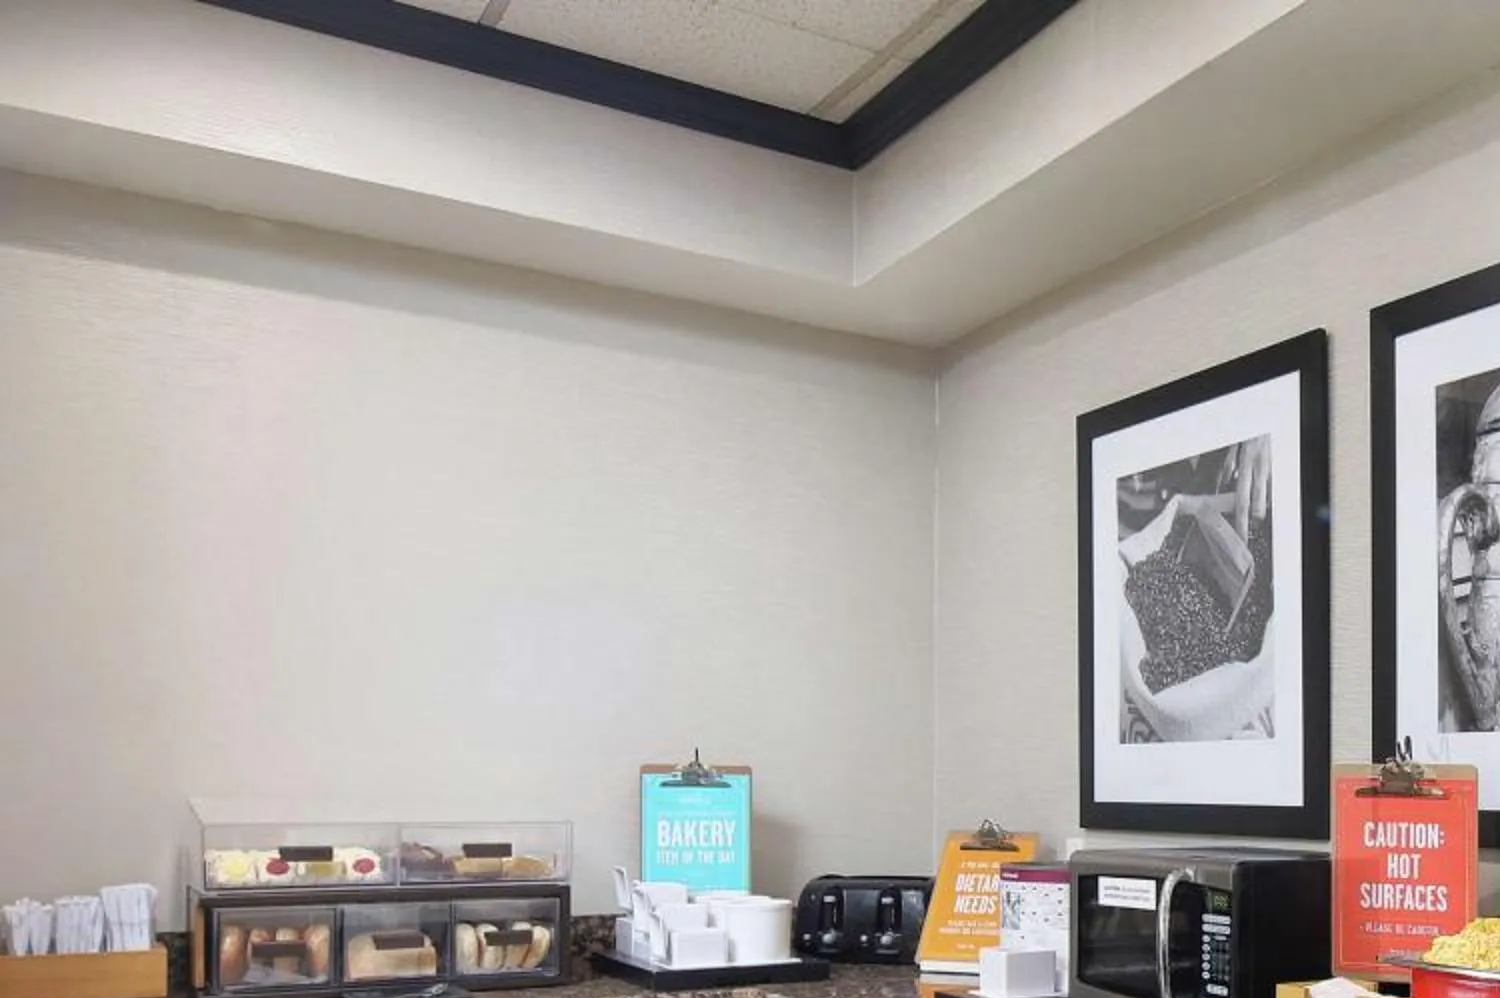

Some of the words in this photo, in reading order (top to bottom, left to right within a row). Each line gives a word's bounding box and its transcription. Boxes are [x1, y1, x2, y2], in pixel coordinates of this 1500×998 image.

[657, 819, 736, 848] BAKERY
[1363, 821, 1445, 848] CAUTION:
[1387, 853, 1422, 879] HOT
[955, 872, 1000, 892] DIETAR
[953, 894, 997, 914] NEEDS
[1360, 883, 1448, 911] SURFACES
